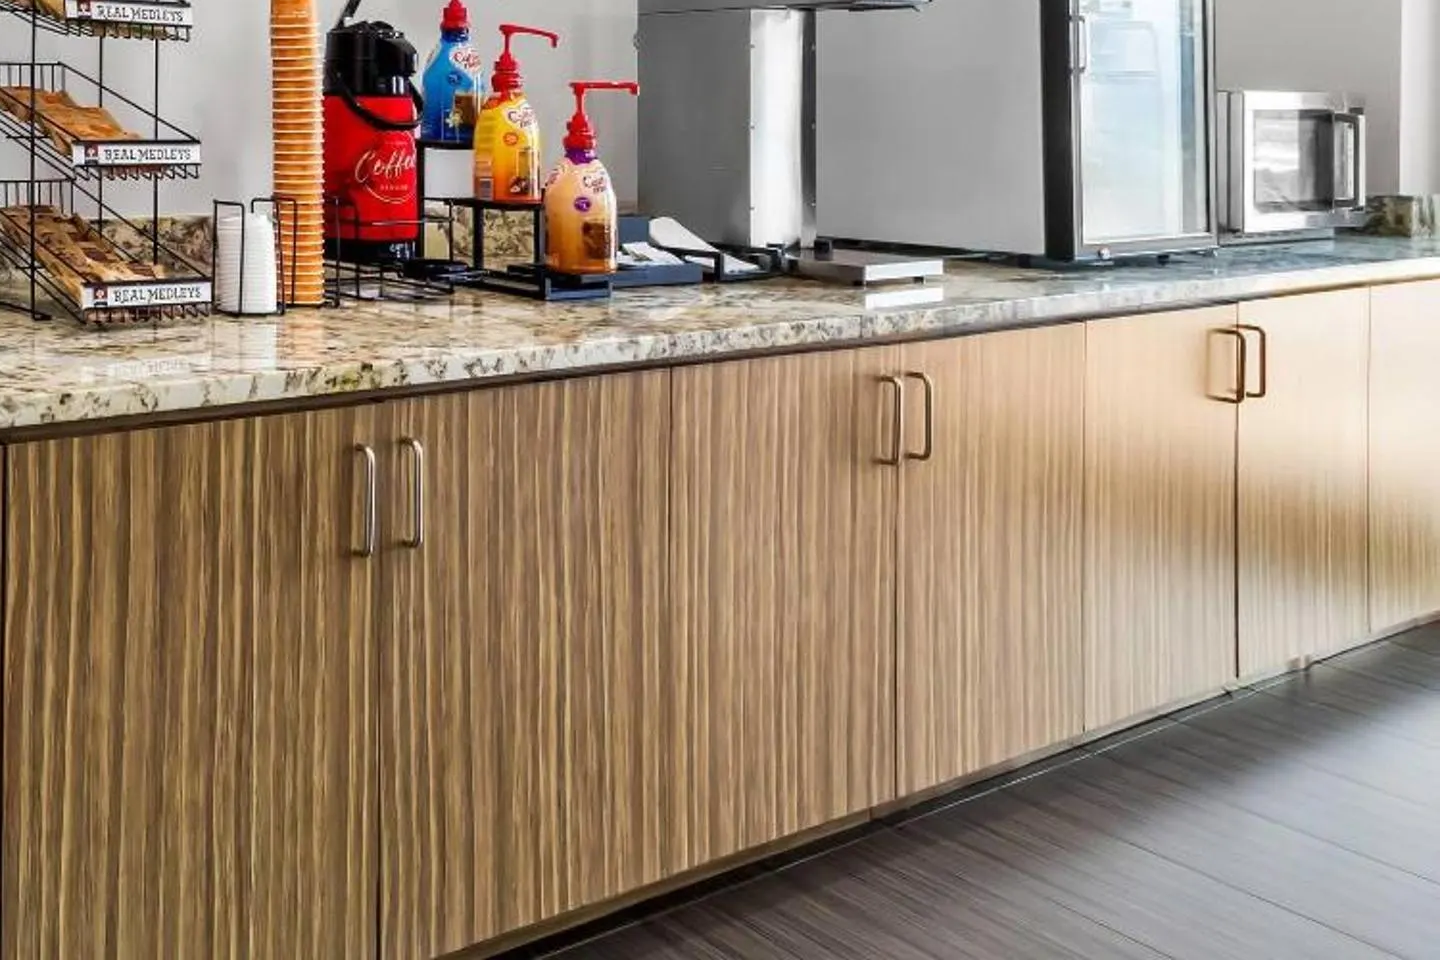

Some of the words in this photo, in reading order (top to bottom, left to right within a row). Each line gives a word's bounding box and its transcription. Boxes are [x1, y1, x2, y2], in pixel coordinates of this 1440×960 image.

[96, 5, 129, 20] REAL
[130, 7, 183, 22] MEDLEYS
[104, 149, 137, 161] REAL
[139, 149, 191, 162] MEDLEYS
[114, 289, 146, 303] REAL
[147, 286, 202, 304] MEDLEYS
